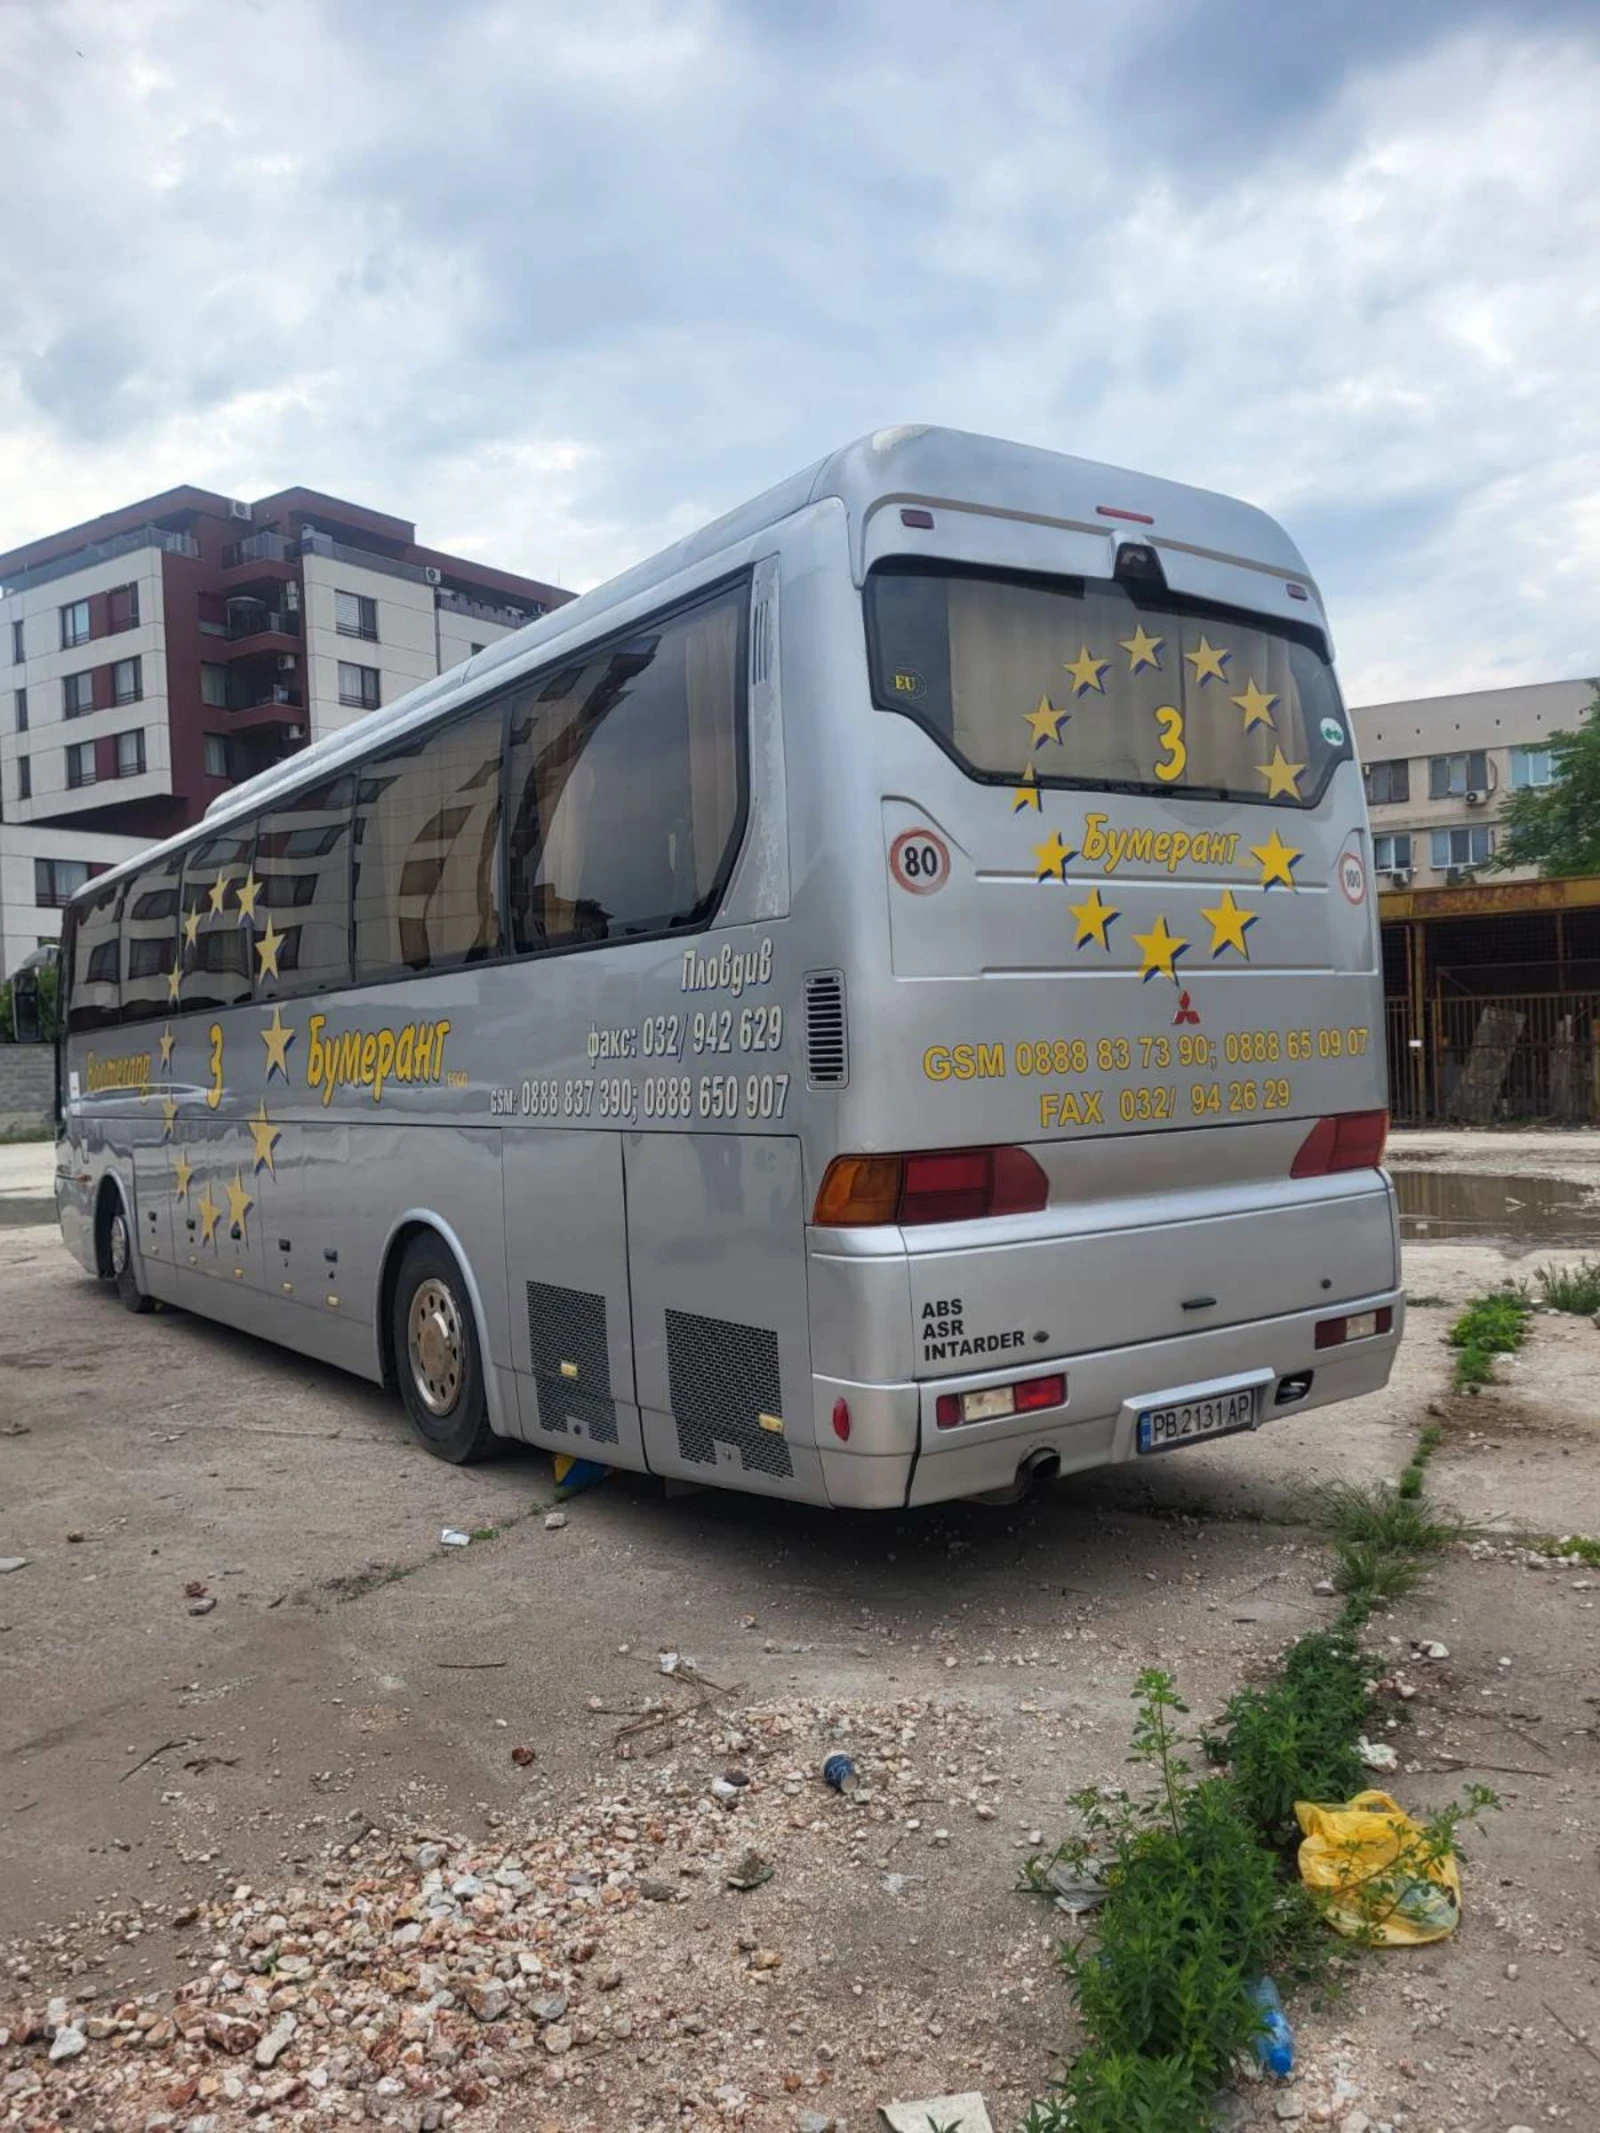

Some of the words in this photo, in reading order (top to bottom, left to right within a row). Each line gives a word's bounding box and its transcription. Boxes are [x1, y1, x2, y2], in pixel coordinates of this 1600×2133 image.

[1154, 706, 1186, 782] 3
[904, 845, 938, 877] 80
[1082, 813, 1241, 873] Бумеранг
[1345, 868, 1361, 888] 100
[680, 937, 773, 998] Пловдив
[306, 1014, 451, 1107] Бумеранг
[587, 1022, 637, 1068] факс:
[641, 1012, 689, 1062] 032/
[692, 1010, 731, 1054] 942
[738, 1005, 782, 1051] 629
[923, 1042, 1005, 1081] GSM
[1015, 1040, 1088, 1076] 0888
[1097, 1036, 1131, 1071] 83
[1138, 1035, 1171, 1068] 73
[1178, 1032, 1218, 1072] 90;
[1224, 1030, 1281, 1065] 0888
[1286, 1029, 1313, 1061] 65
[1318, 1028, 1343, 1058] 09
[1347, 1026, 1370, 1057] 07
[206, 1022, 224, 1110] 3
[521, 1081, 558, 1117] 0888
[563, 1079, 594, 1117] 837
[600, 1078, 638, 1125] 390;
[643, 1077, 692, 1119] 0888
[699, 1075, 738, 1119] 650
[745, 1073, 790, 1119] 907
[1039, 1091, 1106, 1128] FAX
[1118, 1085, 1177, 1122] 032/
[1190, 1081, 1222, 1116] 94
[1227, 1079, 1258, 1111] 26
[1263, 1076, 1291, 1110] 29
[921, 1298, 964, 1320] ABS
[922, 1319, 965, 1340] ASR
[924, 1330, 1026, 1362] INTARDER
